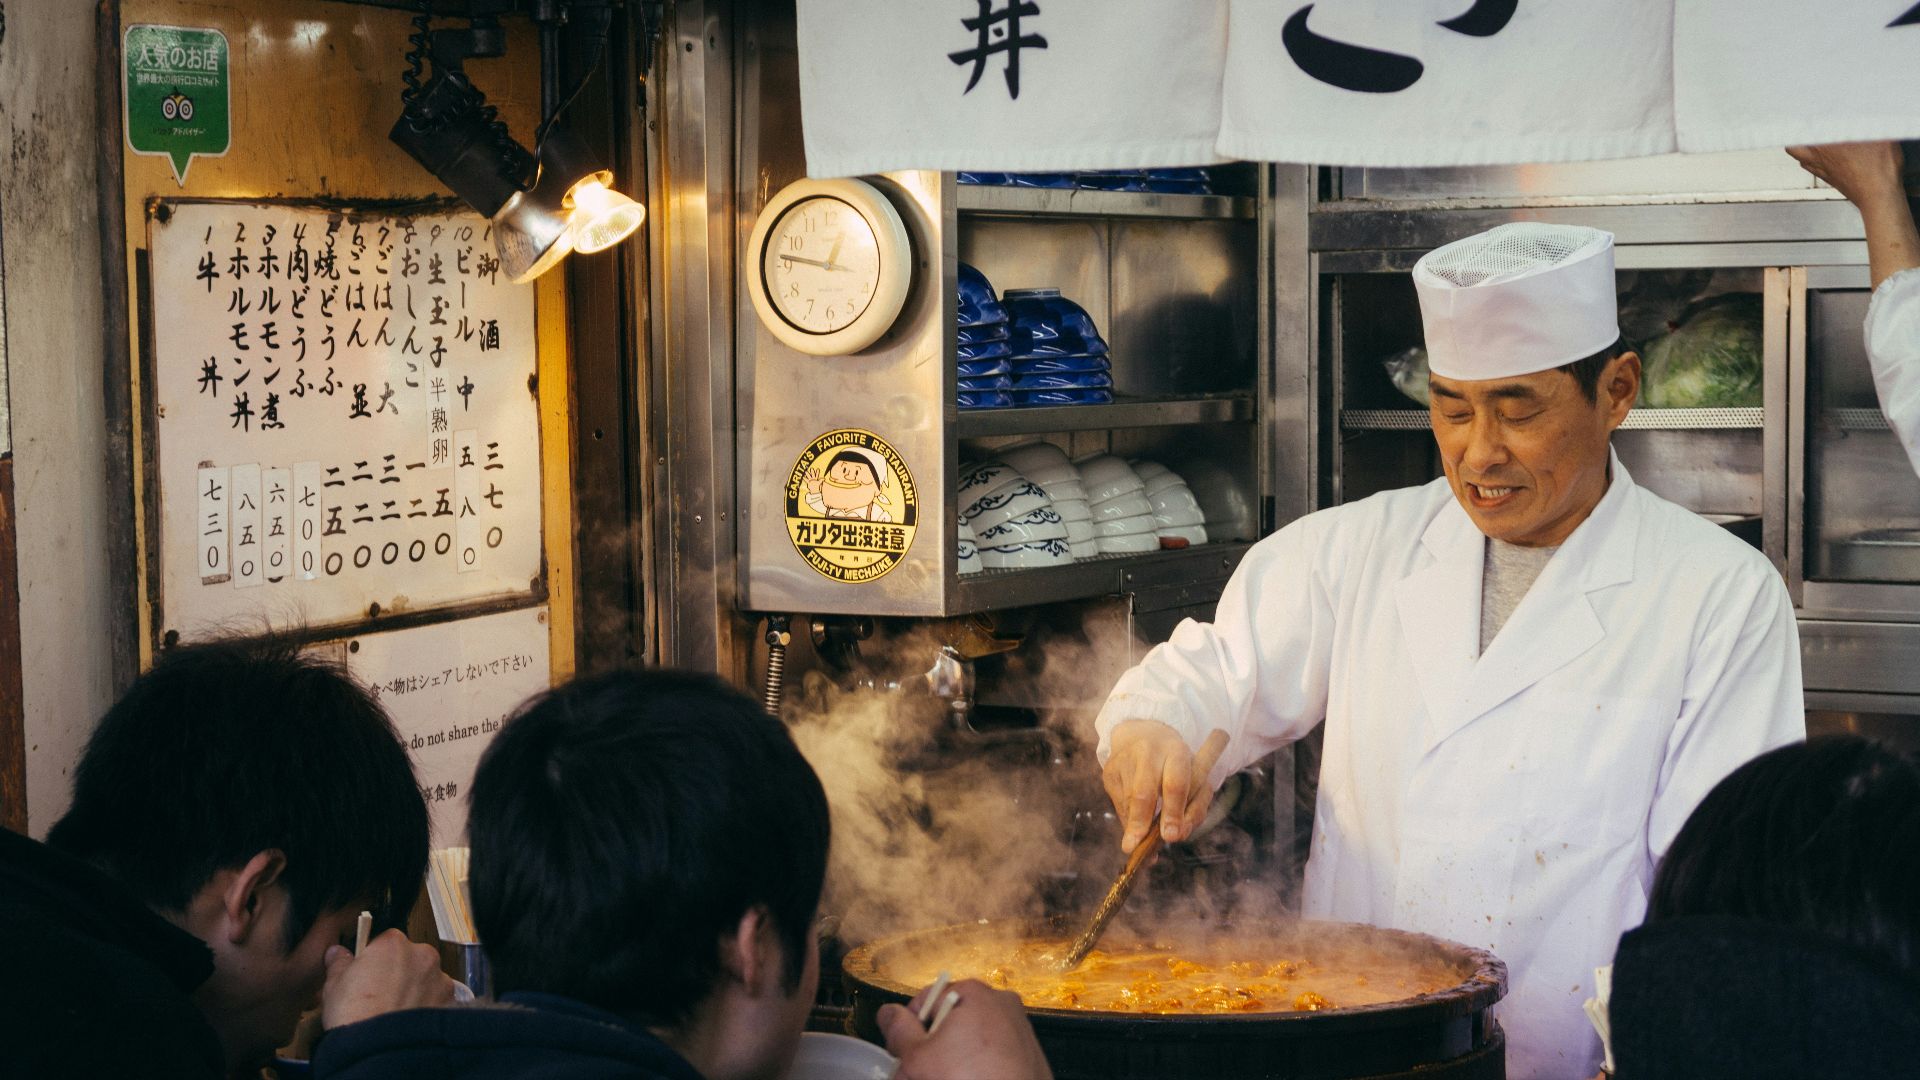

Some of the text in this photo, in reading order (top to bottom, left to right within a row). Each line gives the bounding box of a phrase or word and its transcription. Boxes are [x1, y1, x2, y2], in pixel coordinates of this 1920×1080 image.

[136, 43, 219, 71] 人気のお店
[805, 218, 815, 233] 11
[824, 211, 838, 226] 12
[204, 226, 212, 244] 1
[234, 222, 245, 243] 2
[262, 224, 277, 246] 3
[293, 223, 307, 247] 4
[325, 222, 339, 247] 5
[352, 224, 364, 246] 6
[378, 226, 390, 246] 7
[403, 225, 417, 244] 8
[430, 224, 443, 246] 9
[454, 225, 473, 242] 10
[789, 237, 803, 251] 10
[784, 259, 793, 274] 9
[346, 245, 368, 348] ごはん
[373, 244, 396, 346] ごはん
[454, 246, 475, 342] ビール
[791, 282, 799, 298] 8
[401, 247, 423, 387] おしんこ
[806, 299, 815, 315] 7
[826, 305, 835, 320] 6
[846, 299, 855, 315] 5
[287, 247, 314, 397] 肉どうふ
[257, 247, 285, 431] ホルモン煮
[789, 433, 914, 507] GARITA'S FAVORITE RESTAURANT
[796, 521, 906, 550] ガリタ出没注意
[807, 550, 893, 580] FUJI-TV MECHAIKE
[369, 653, 533, 700] 食べ物はシェアしないで下さい
[411, 733, 424, 750] do
[427, 732, 445, 746] not
[448, 725, 479, 742] share
[481, 717, 499, 733] the
